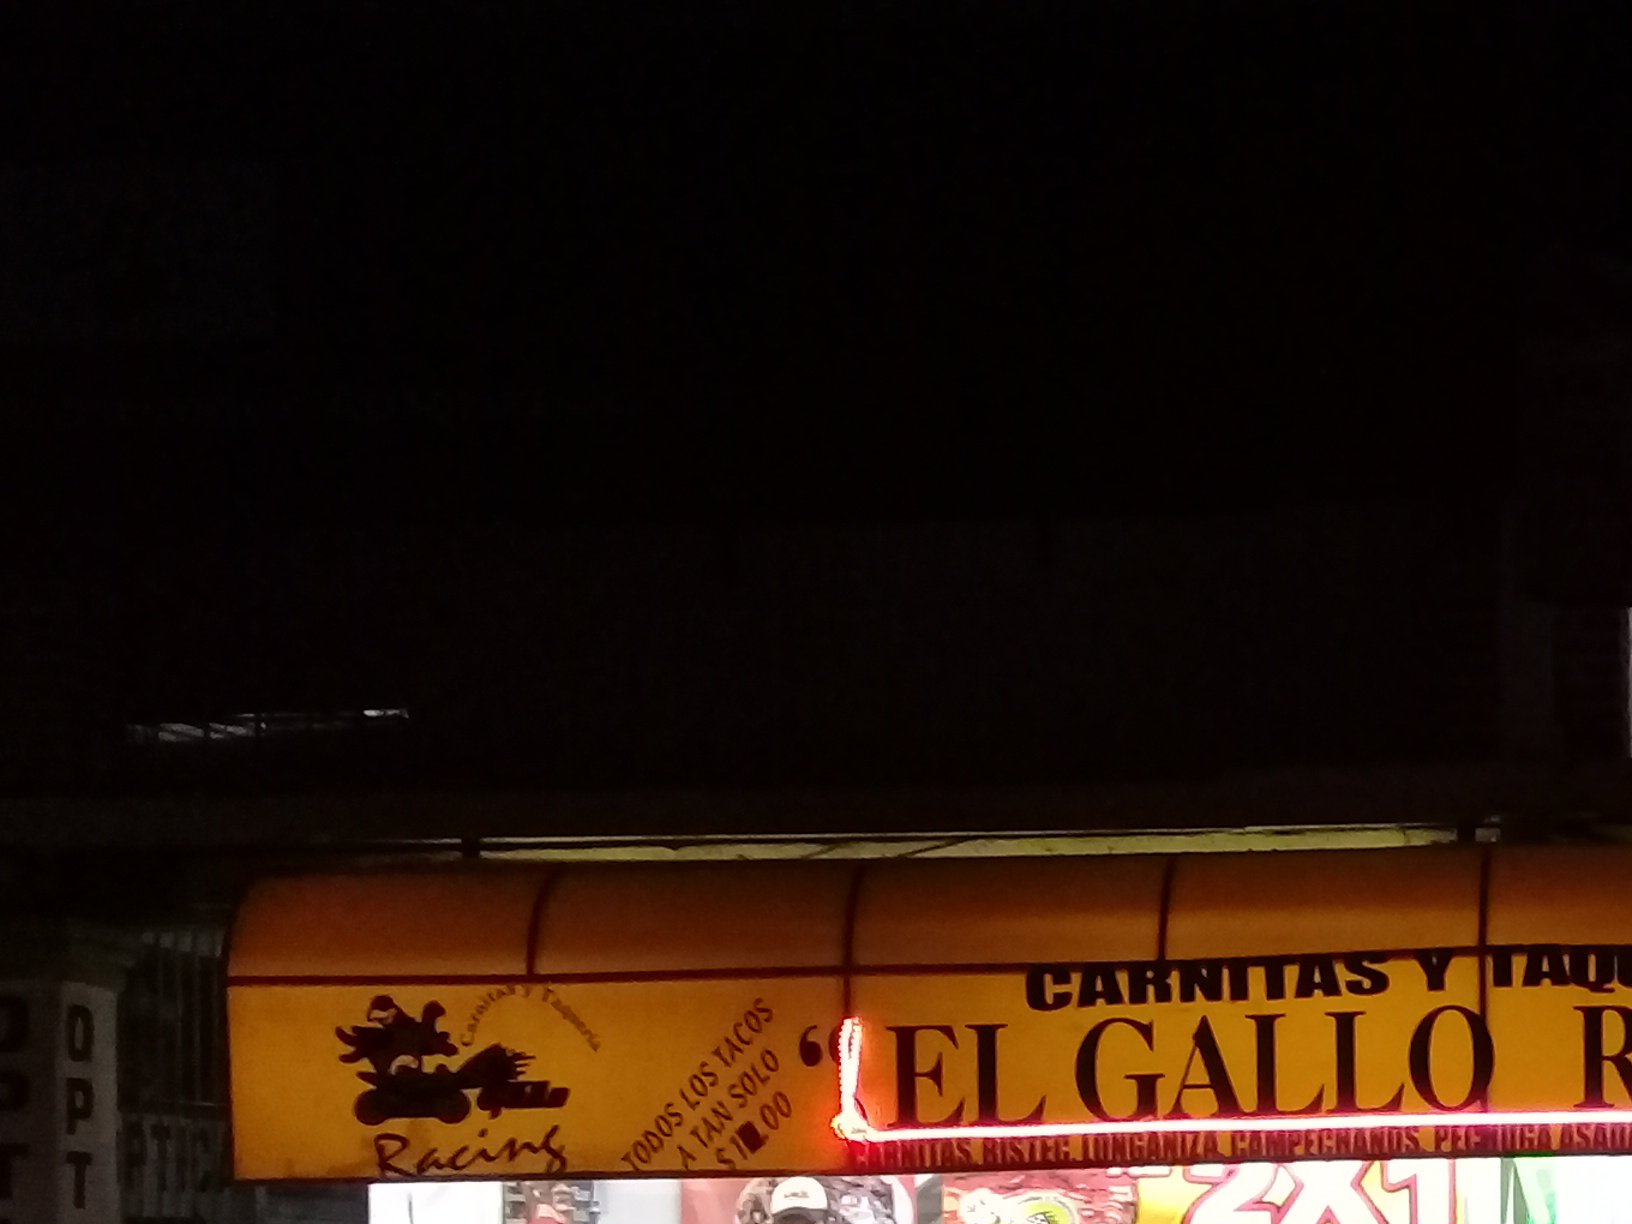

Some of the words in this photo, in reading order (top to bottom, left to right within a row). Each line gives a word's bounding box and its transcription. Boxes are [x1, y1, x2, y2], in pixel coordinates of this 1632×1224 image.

[1025, 954, 1390, 1011] CARNITAS
[1411, 949, 1455, 991] Y
[620, 1101, 684, 1171] TODOS
[679, 1060, 720, 1111] LOS
[712, 997, 774, 1067] TACOS
[677, 1144, 697, 1171] A
[689, 1101, 733, 1149] TAN
[728, 1049, 780, 1109] SOLO
[1074, 1005, 1494, 1123] GALLO
[373, 1123, 567, 1177] Racing
[715, 1091, 792, 1170] $1.00
